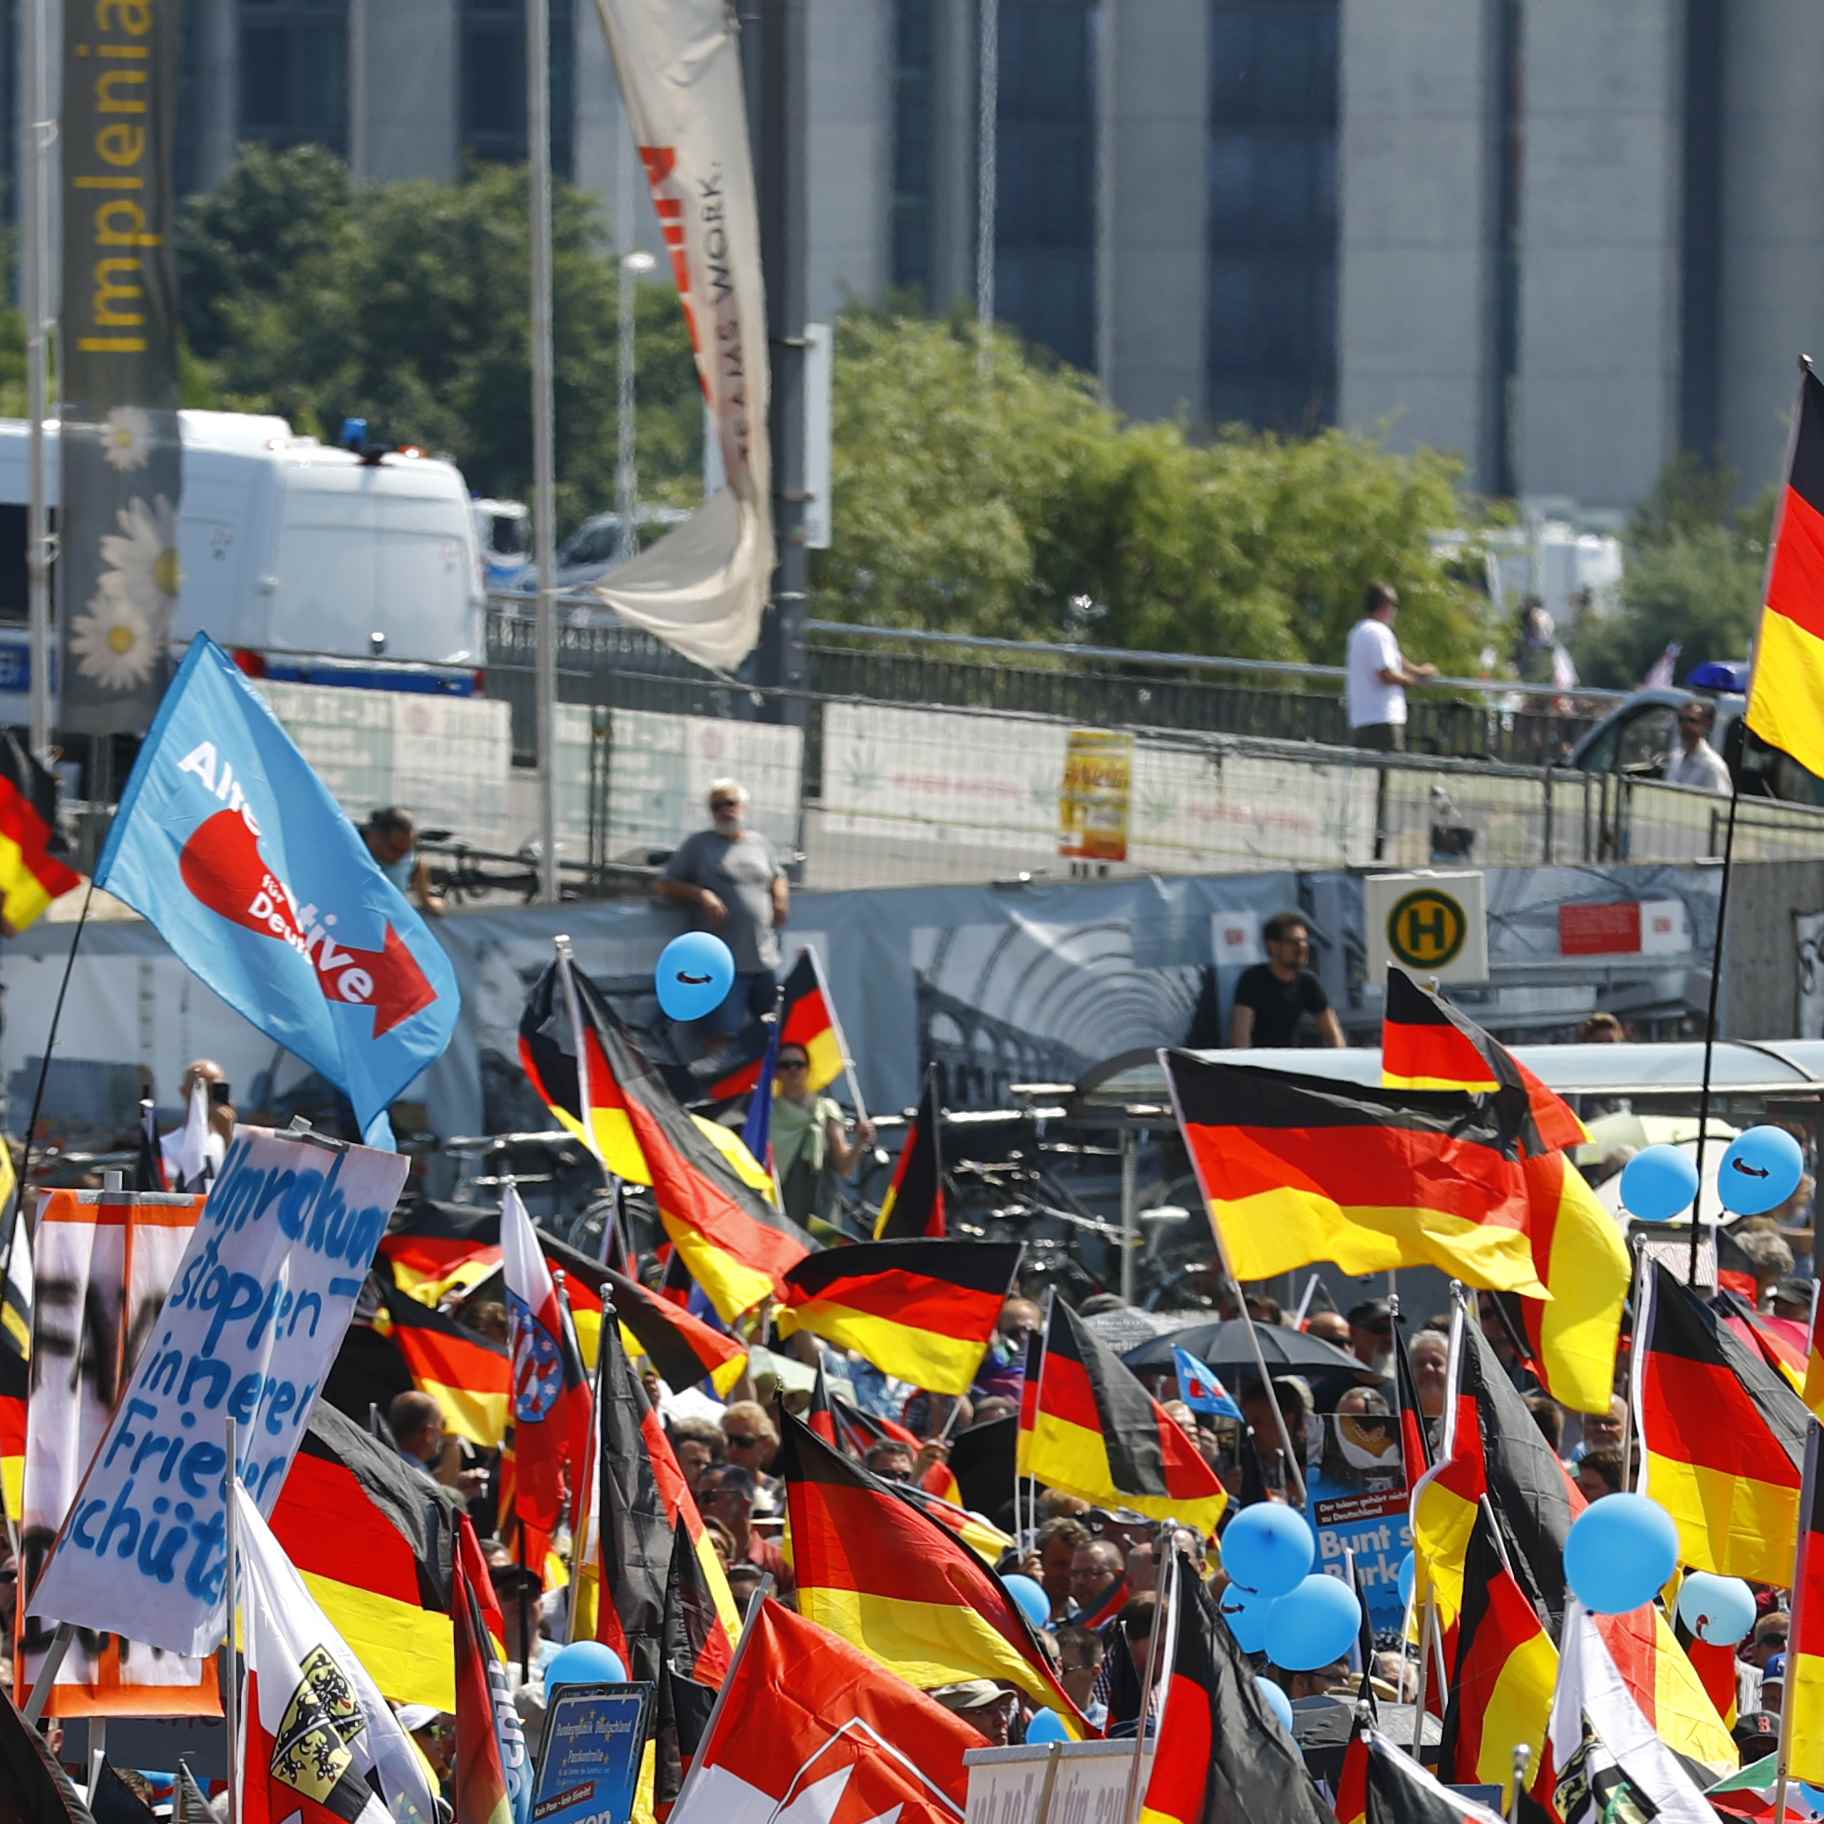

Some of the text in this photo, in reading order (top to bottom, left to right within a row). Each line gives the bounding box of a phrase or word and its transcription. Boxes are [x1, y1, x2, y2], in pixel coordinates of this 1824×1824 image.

[75, 0, 162, 353] Implenia
[1409, 898, 1445, 951] H
[1318, 1524, 1392, 1561] Bunt
